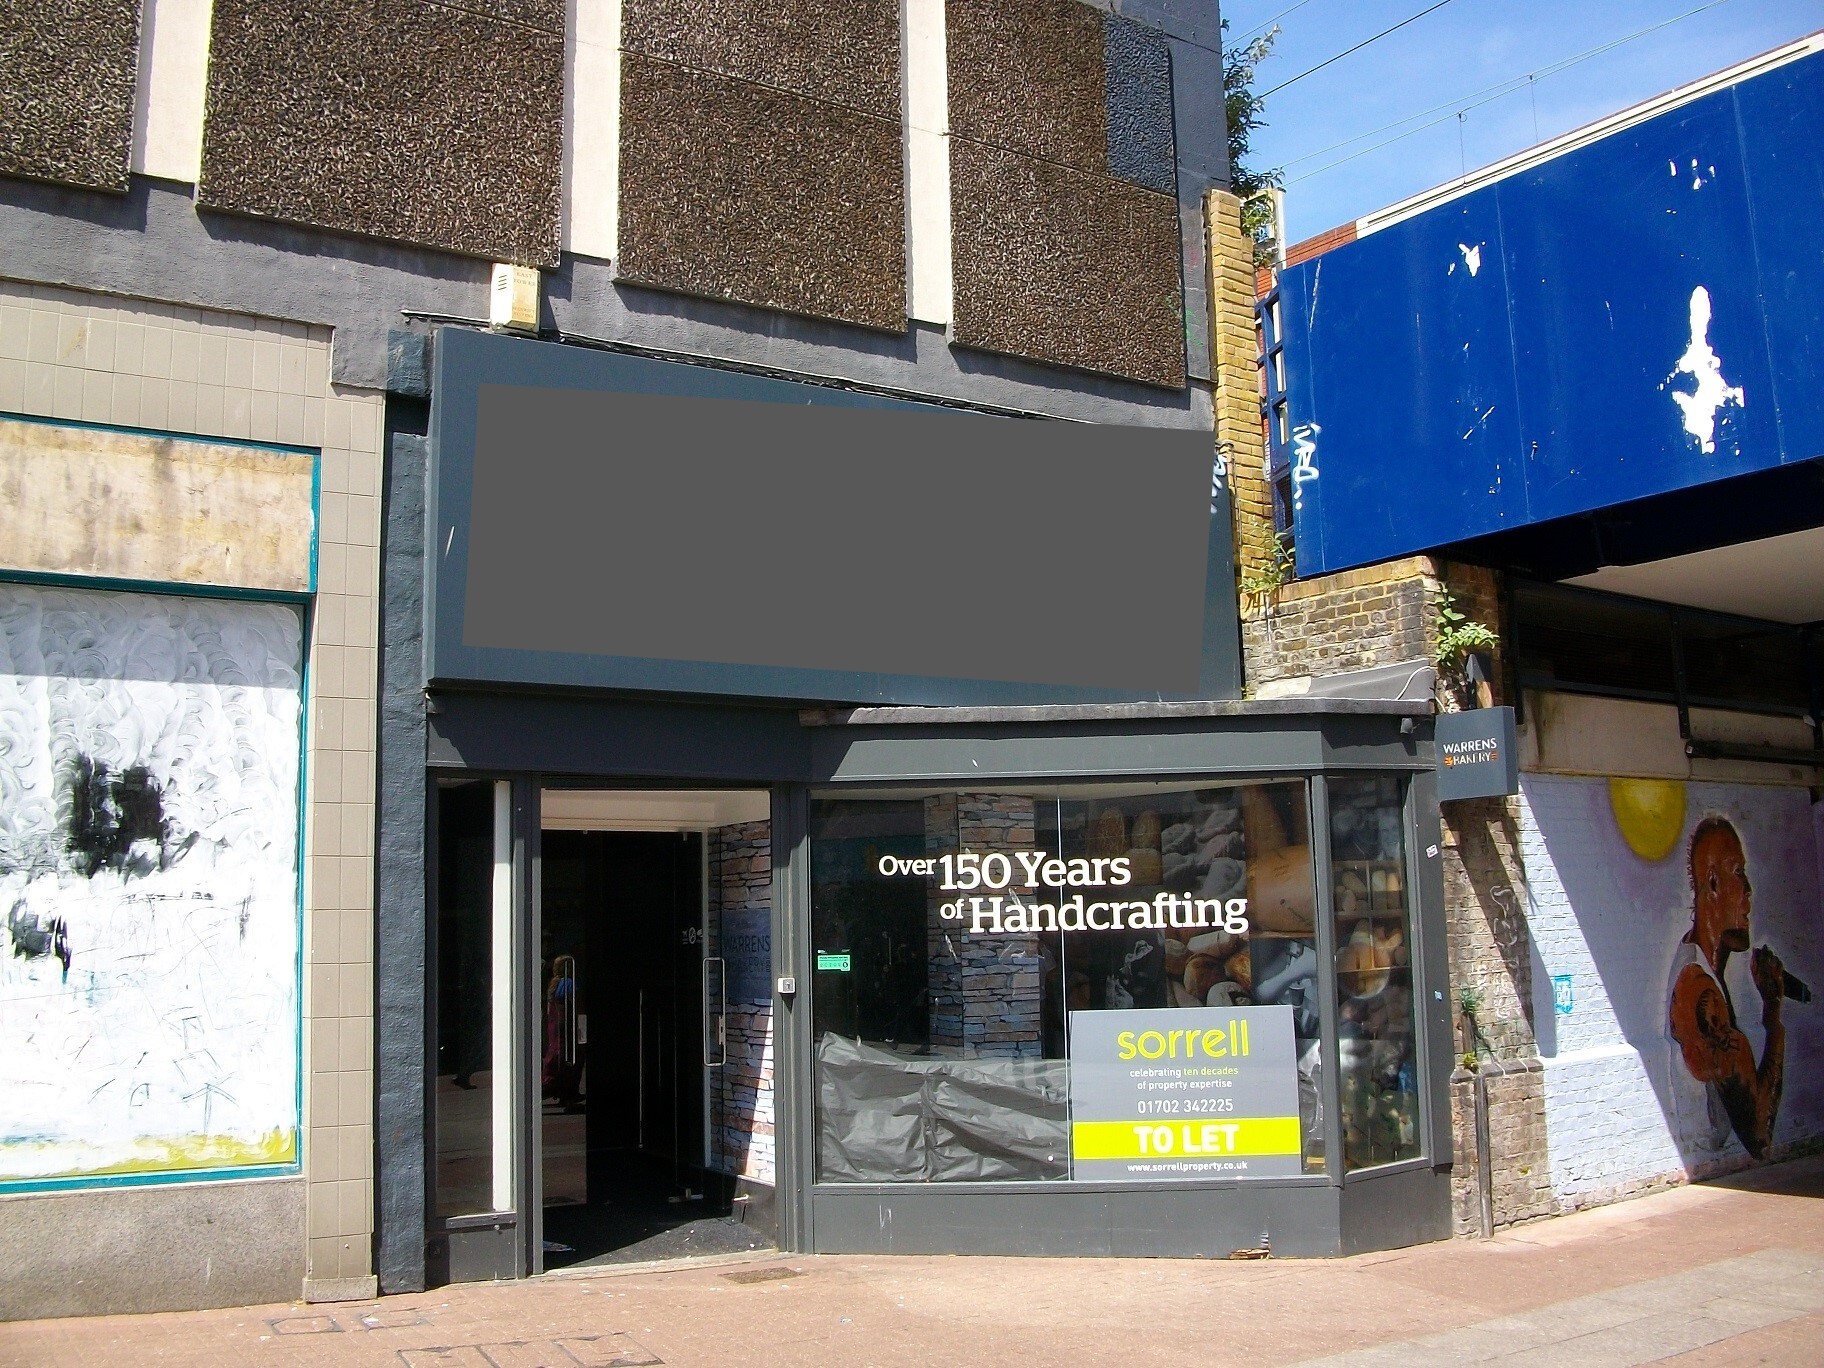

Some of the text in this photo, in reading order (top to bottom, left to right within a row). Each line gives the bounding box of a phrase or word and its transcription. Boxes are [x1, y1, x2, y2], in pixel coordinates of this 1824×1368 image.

[1443, 738, 1497, 754] WARRENS
[878, 851, 1131, 891] Over 150 Years
[940, 892, 1249, 935] of Handcrafting
[1117, 1019, 1249, 1060] sorrell
[1129, 1066, 1239, 1079] celebrating ten decades
[1137, 1079, 1232, 1091] of property expertise
[1137, 1099, 1233, 1114] 01702 342225
[1133, 1124, 1240, 1154] TO LET
[1127, 1161, 1248, 1173] www.sorrellproperty.co.uk
